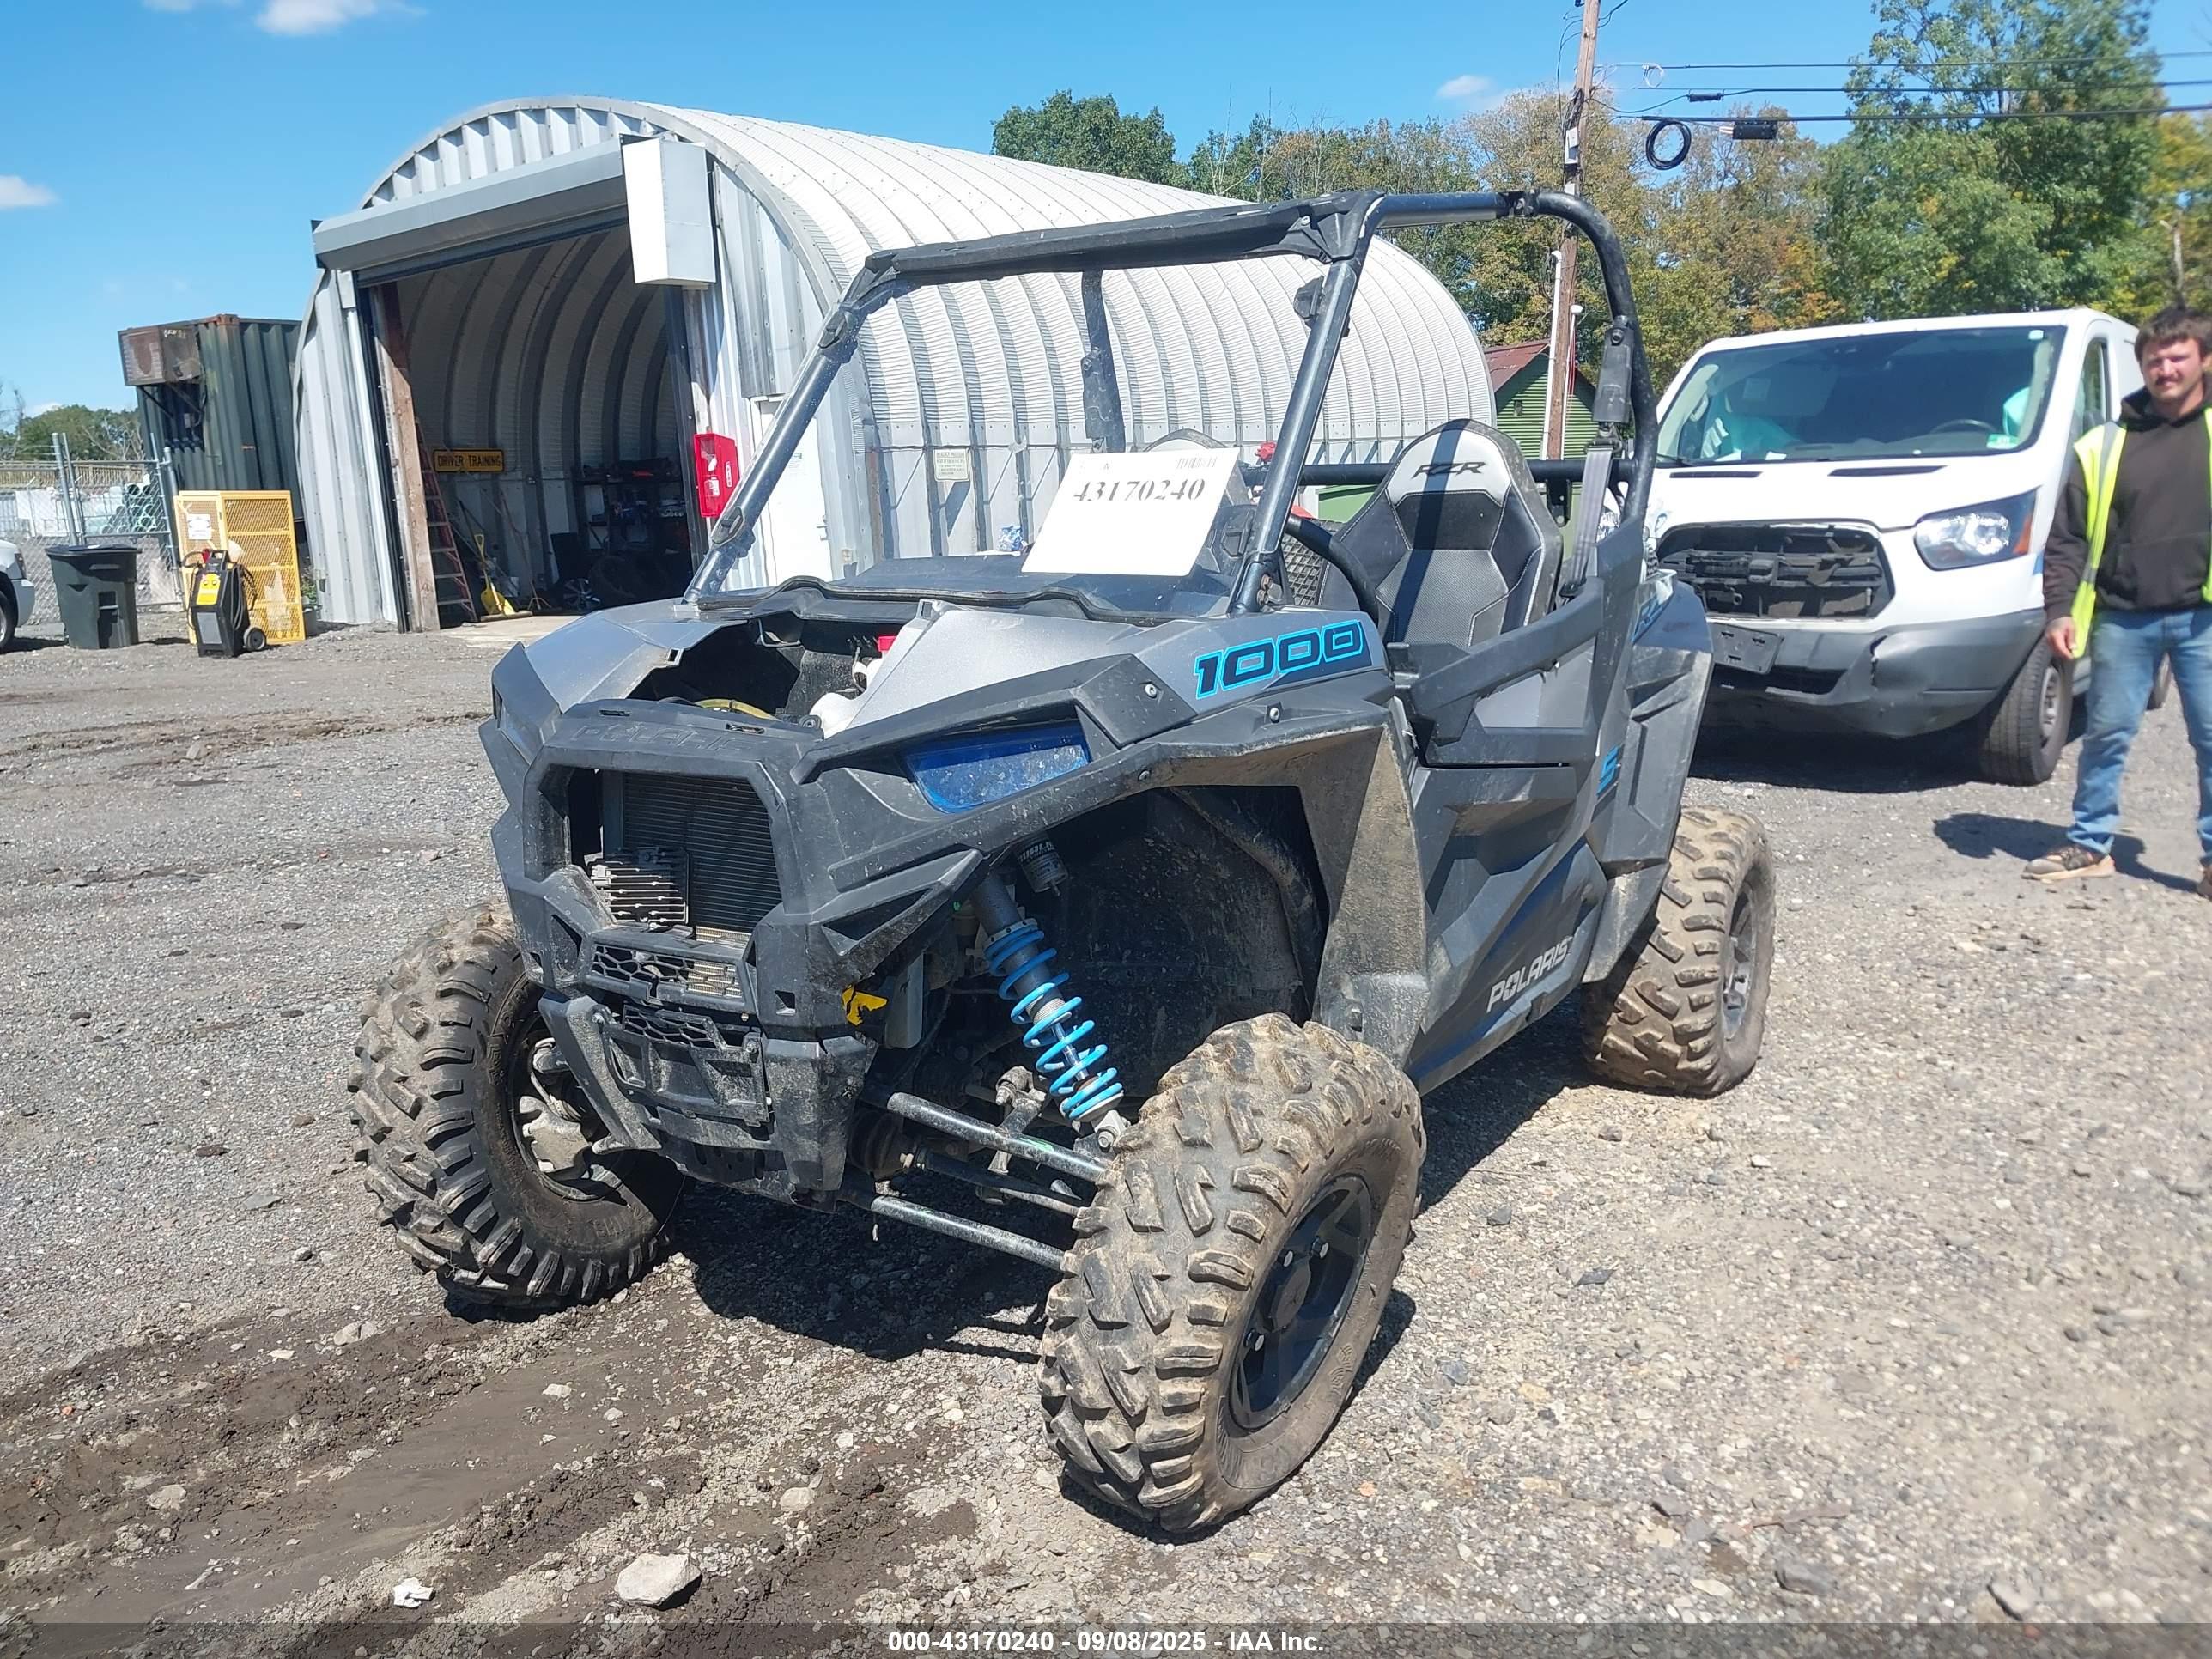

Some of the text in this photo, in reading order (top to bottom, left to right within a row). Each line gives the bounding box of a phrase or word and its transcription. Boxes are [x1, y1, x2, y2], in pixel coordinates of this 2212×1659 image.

[438, 454, 501, 467] DRIVER TRAINING
[1412, 462, 1486, 479] RZR
[1073, 478, 1206, 502] 43170240
[1194, 619, 1363, 699] 1000
[570, 722, 754, 752] POLARIS
[1486, 936, 1573, 1013] POLARIS
